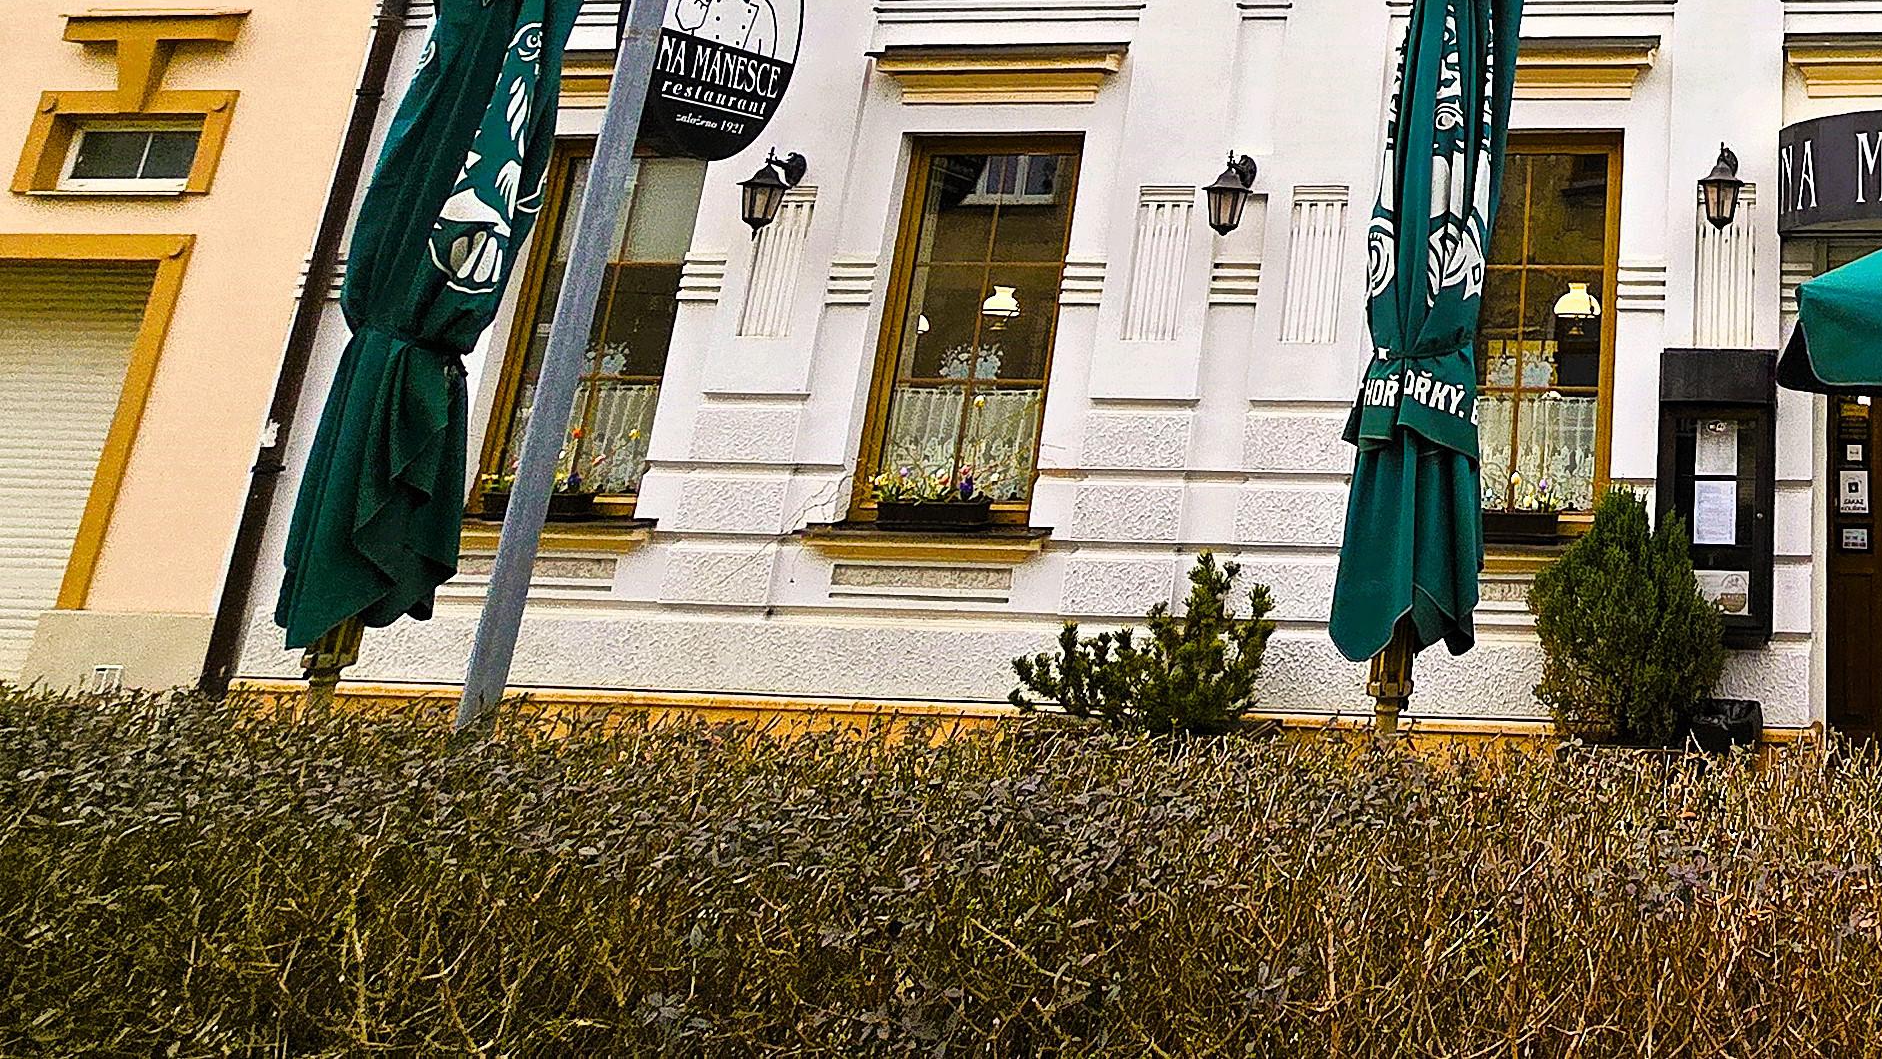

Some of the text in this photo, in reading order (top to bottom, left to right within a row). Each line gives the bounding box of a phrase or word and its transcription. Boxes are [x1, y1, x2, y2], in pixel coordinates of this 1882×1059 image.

[656, 35, 780, 98] NA MÁNESCE
[661, 80, 767, 114] restaurant
[720, 120, 744, 135] 1921
[1780, 139, 1817, 215] NA
